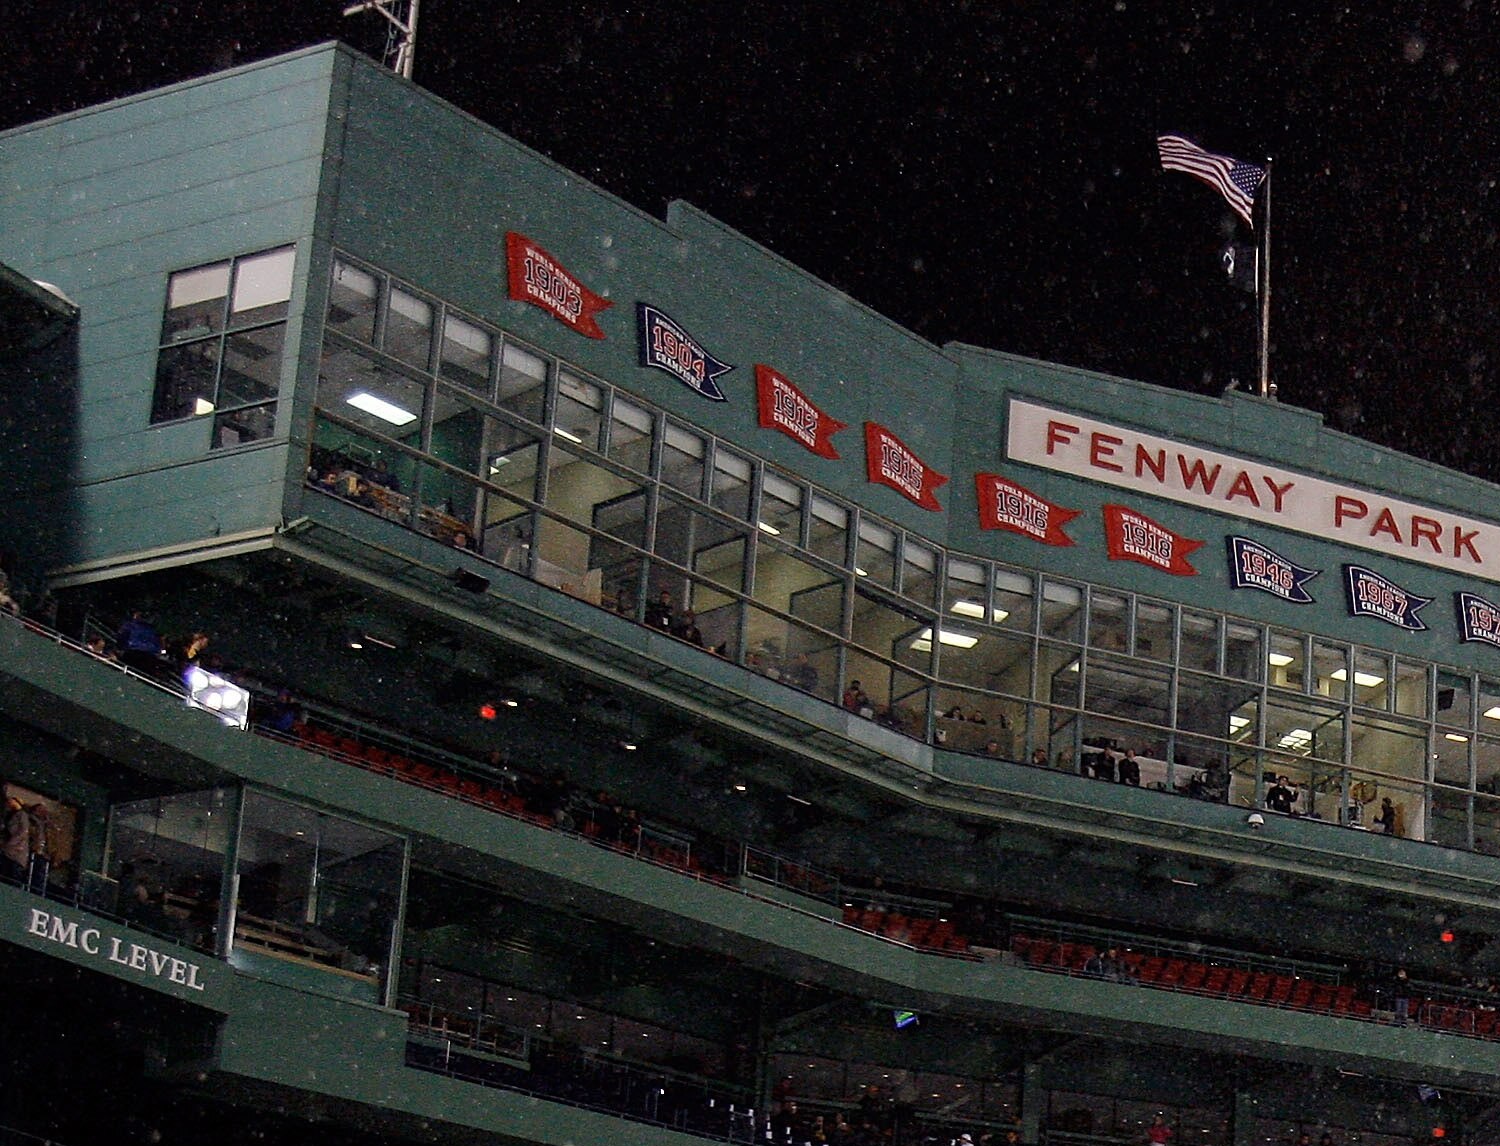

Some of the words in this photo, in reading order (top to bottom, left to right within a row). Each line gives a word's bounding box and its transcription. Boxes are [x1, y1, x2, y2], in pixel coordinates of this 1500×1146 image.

[525, 258, 583, 316] 1903
[527, 284, 576, 324] CHAMPIONS
[653, 326, 705, 382] 1904
[656, 352, 701, 388] CHAMPIONS
[774, 388, 817, 440] 1912
[881, 443, 923, 491] 1915
[996, 491, 1048, 529] 1916
[1046, 420, 1295, 513] FENWAY
[1334, 494, 1483, 564] PARK
[997, 513, 1046, 538] CHAMPIONS
[1122, 522, 1172, 559] 1918
[1123, 543, 1171, 568] CHAMPIONS
[1242, 551, 1294, 590] 1946
[1245, 573, 1290, 597] CHAMPIONS
[1358, 580, 1408, 617] 1967
[1361, 601, 1404, 624] CHAMPIONS
[28, 908, 100, 955] EMC
[109, 937, 205, 991] LEVEL
